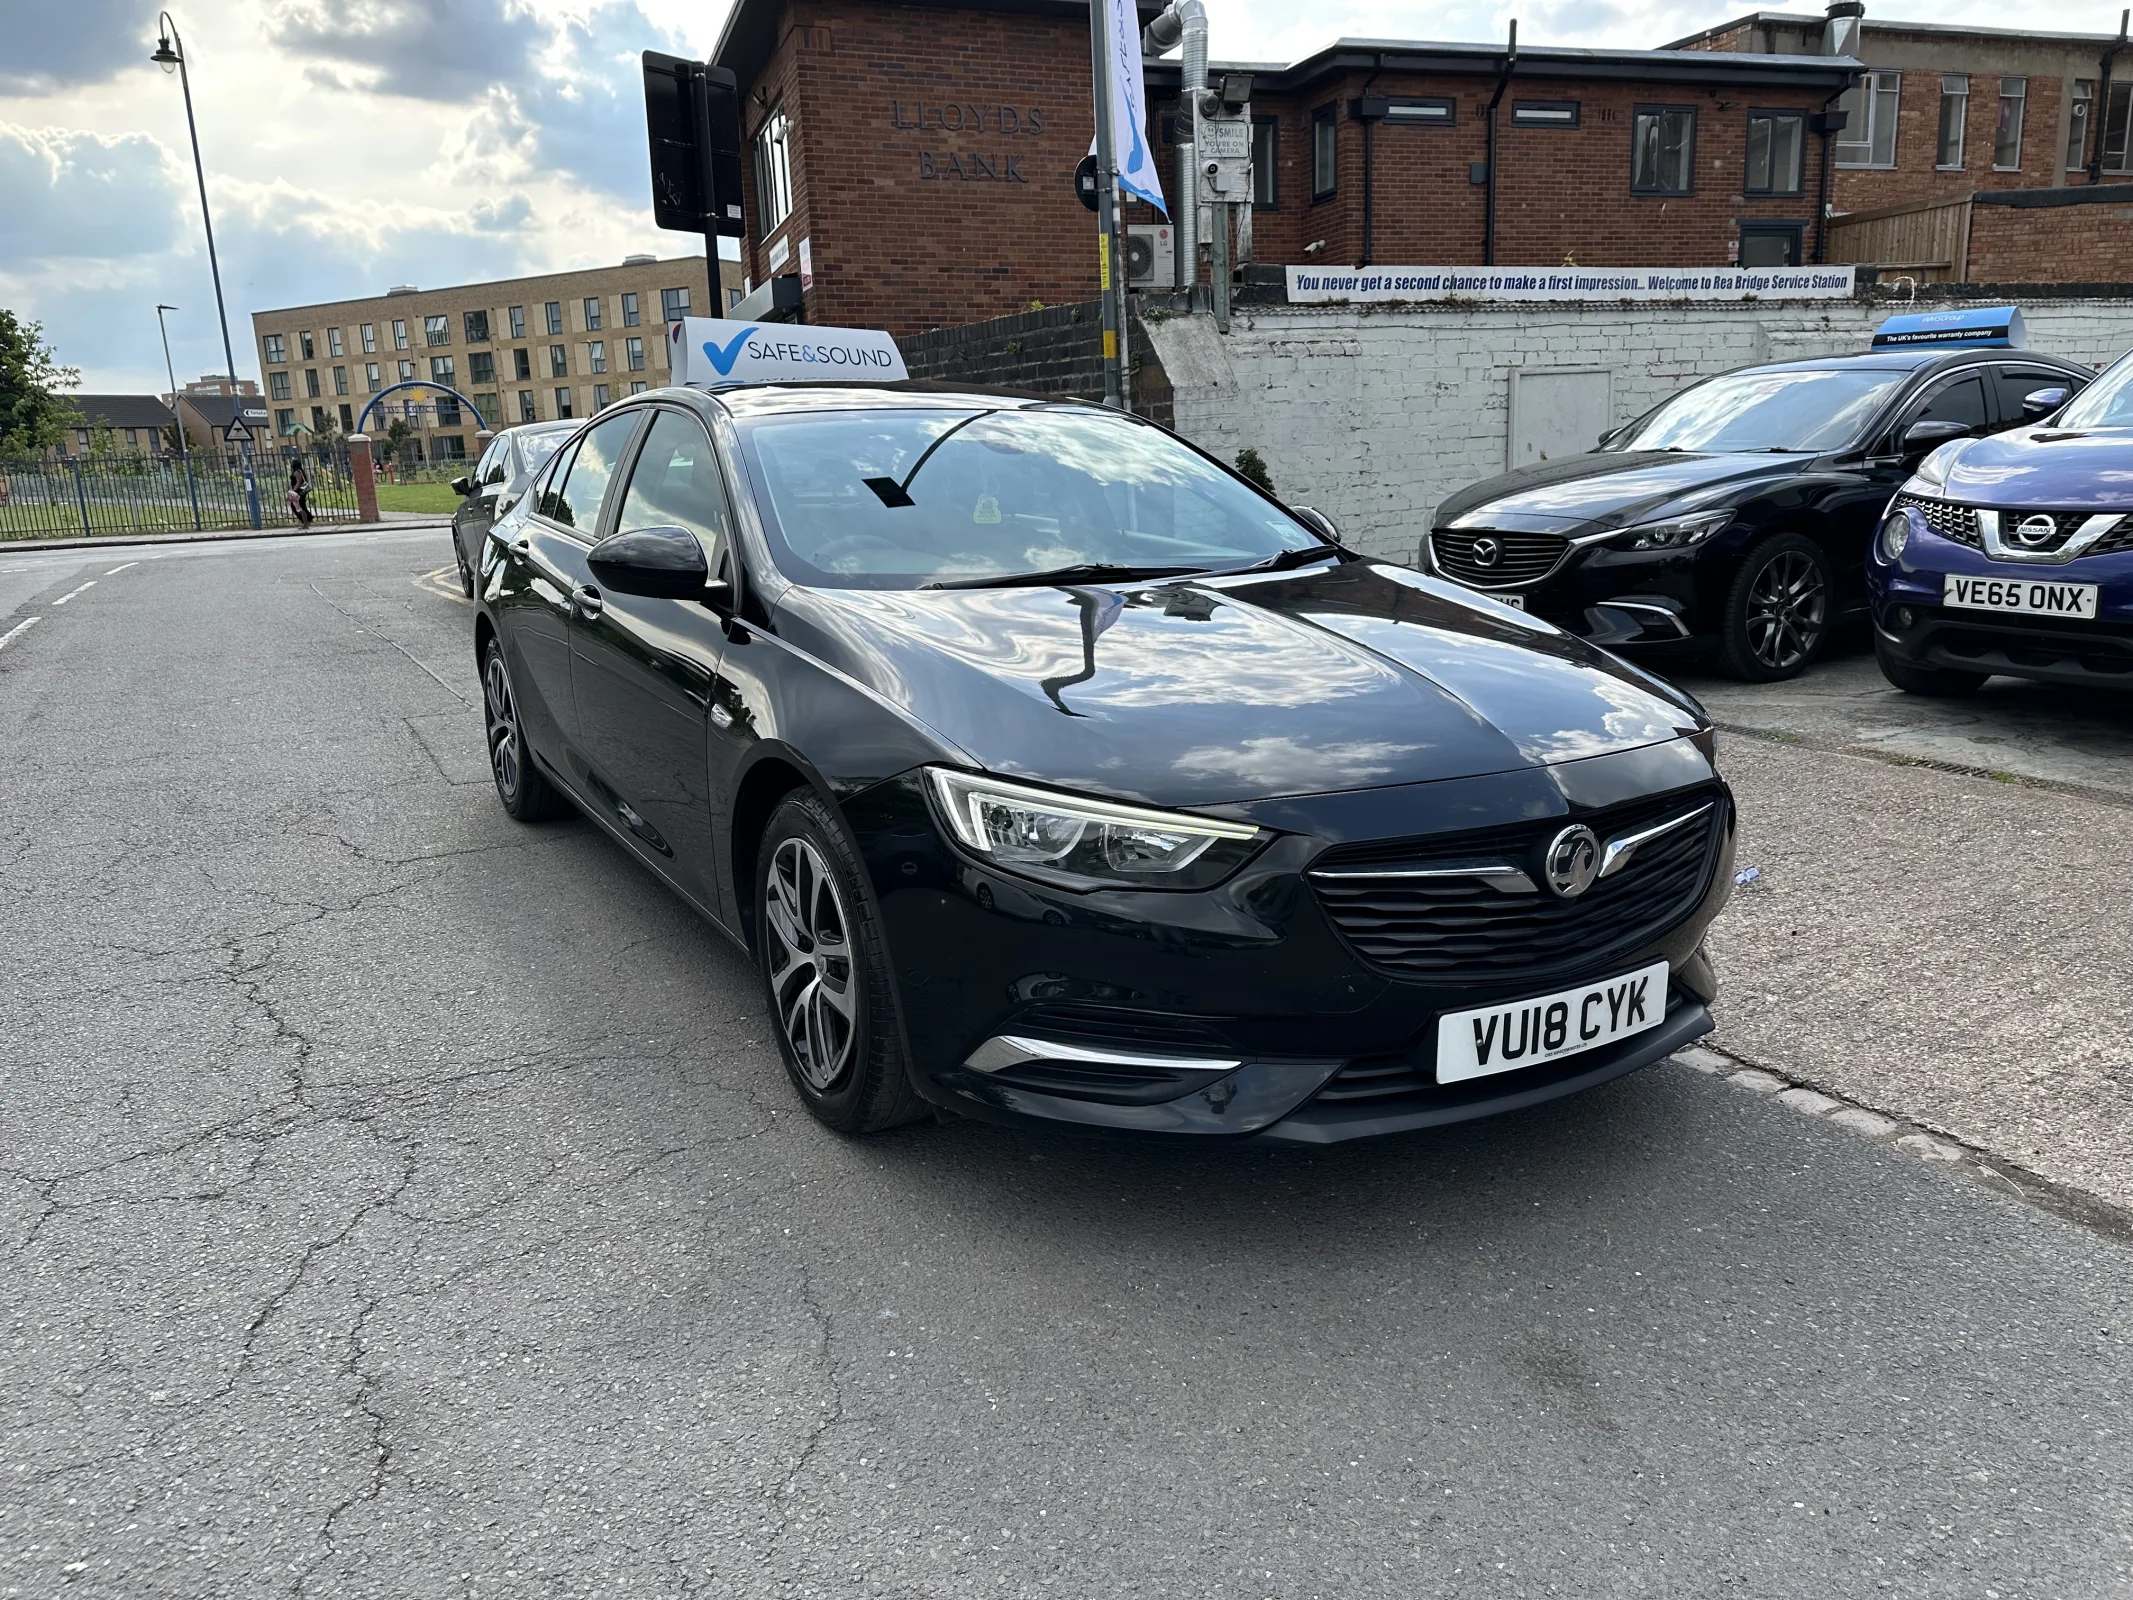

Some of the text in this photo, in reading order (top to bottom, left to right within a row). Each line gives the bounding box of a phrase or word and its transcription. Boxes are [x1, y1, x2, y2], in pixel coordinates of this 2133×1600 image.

[894, 100, 1044, 135] LLOYDS
[1219, 128, 1244, 138] SMILE
[1232, 140, 1244, 148] ON
[919, 151, 1029, 183] BANK
[1297, 274, 1848, 292] You never get a second chance to make a first impression... Welcome to Rea Bridge Service Station
[1912, 333, 1937, 341] favourite
[1938, 331, 1963, 339] warranty
[747, 341, 892, 367] SAFE&SOUND
[1956, 579, 2022, 607] VE65
[1473, 975, 1649, 1066] VU18 CYK
